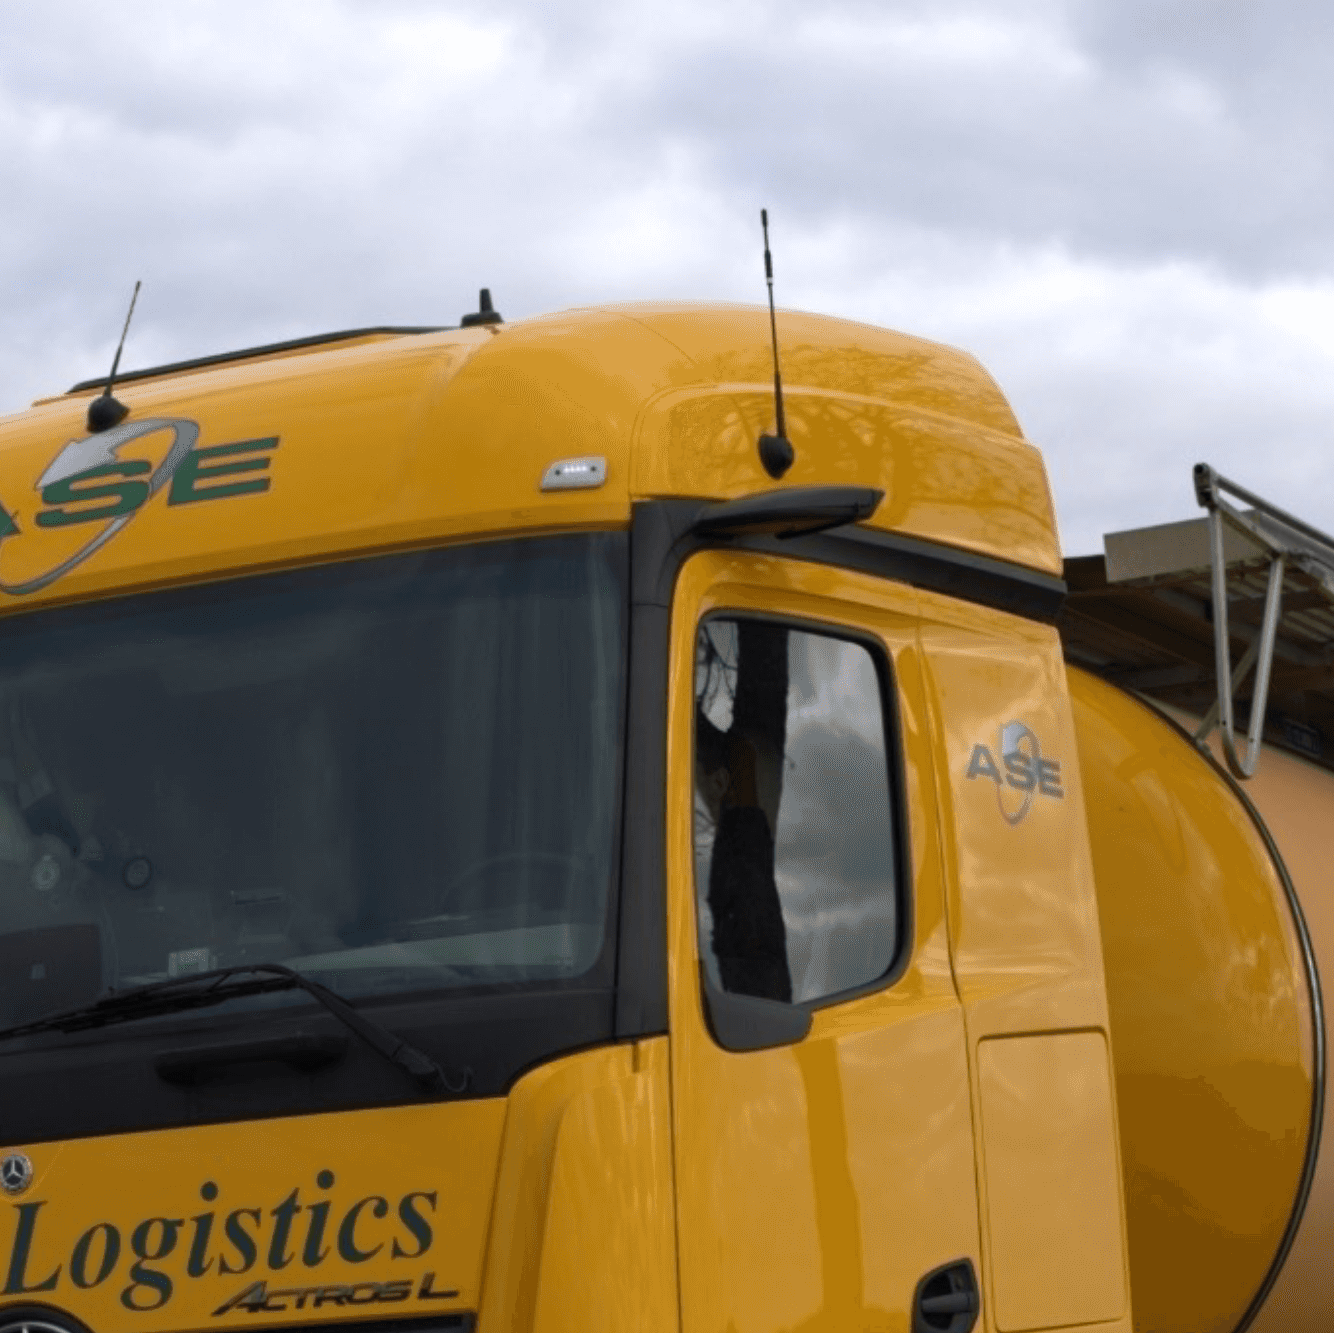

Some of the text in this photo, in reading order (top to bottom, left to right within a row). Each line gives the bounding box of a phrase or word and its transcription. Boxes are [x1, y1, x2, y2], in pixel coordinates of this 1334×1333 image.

[966, 743, 1064, 800] ASE
[210, 1271, 461, 1317] ACTROS L
